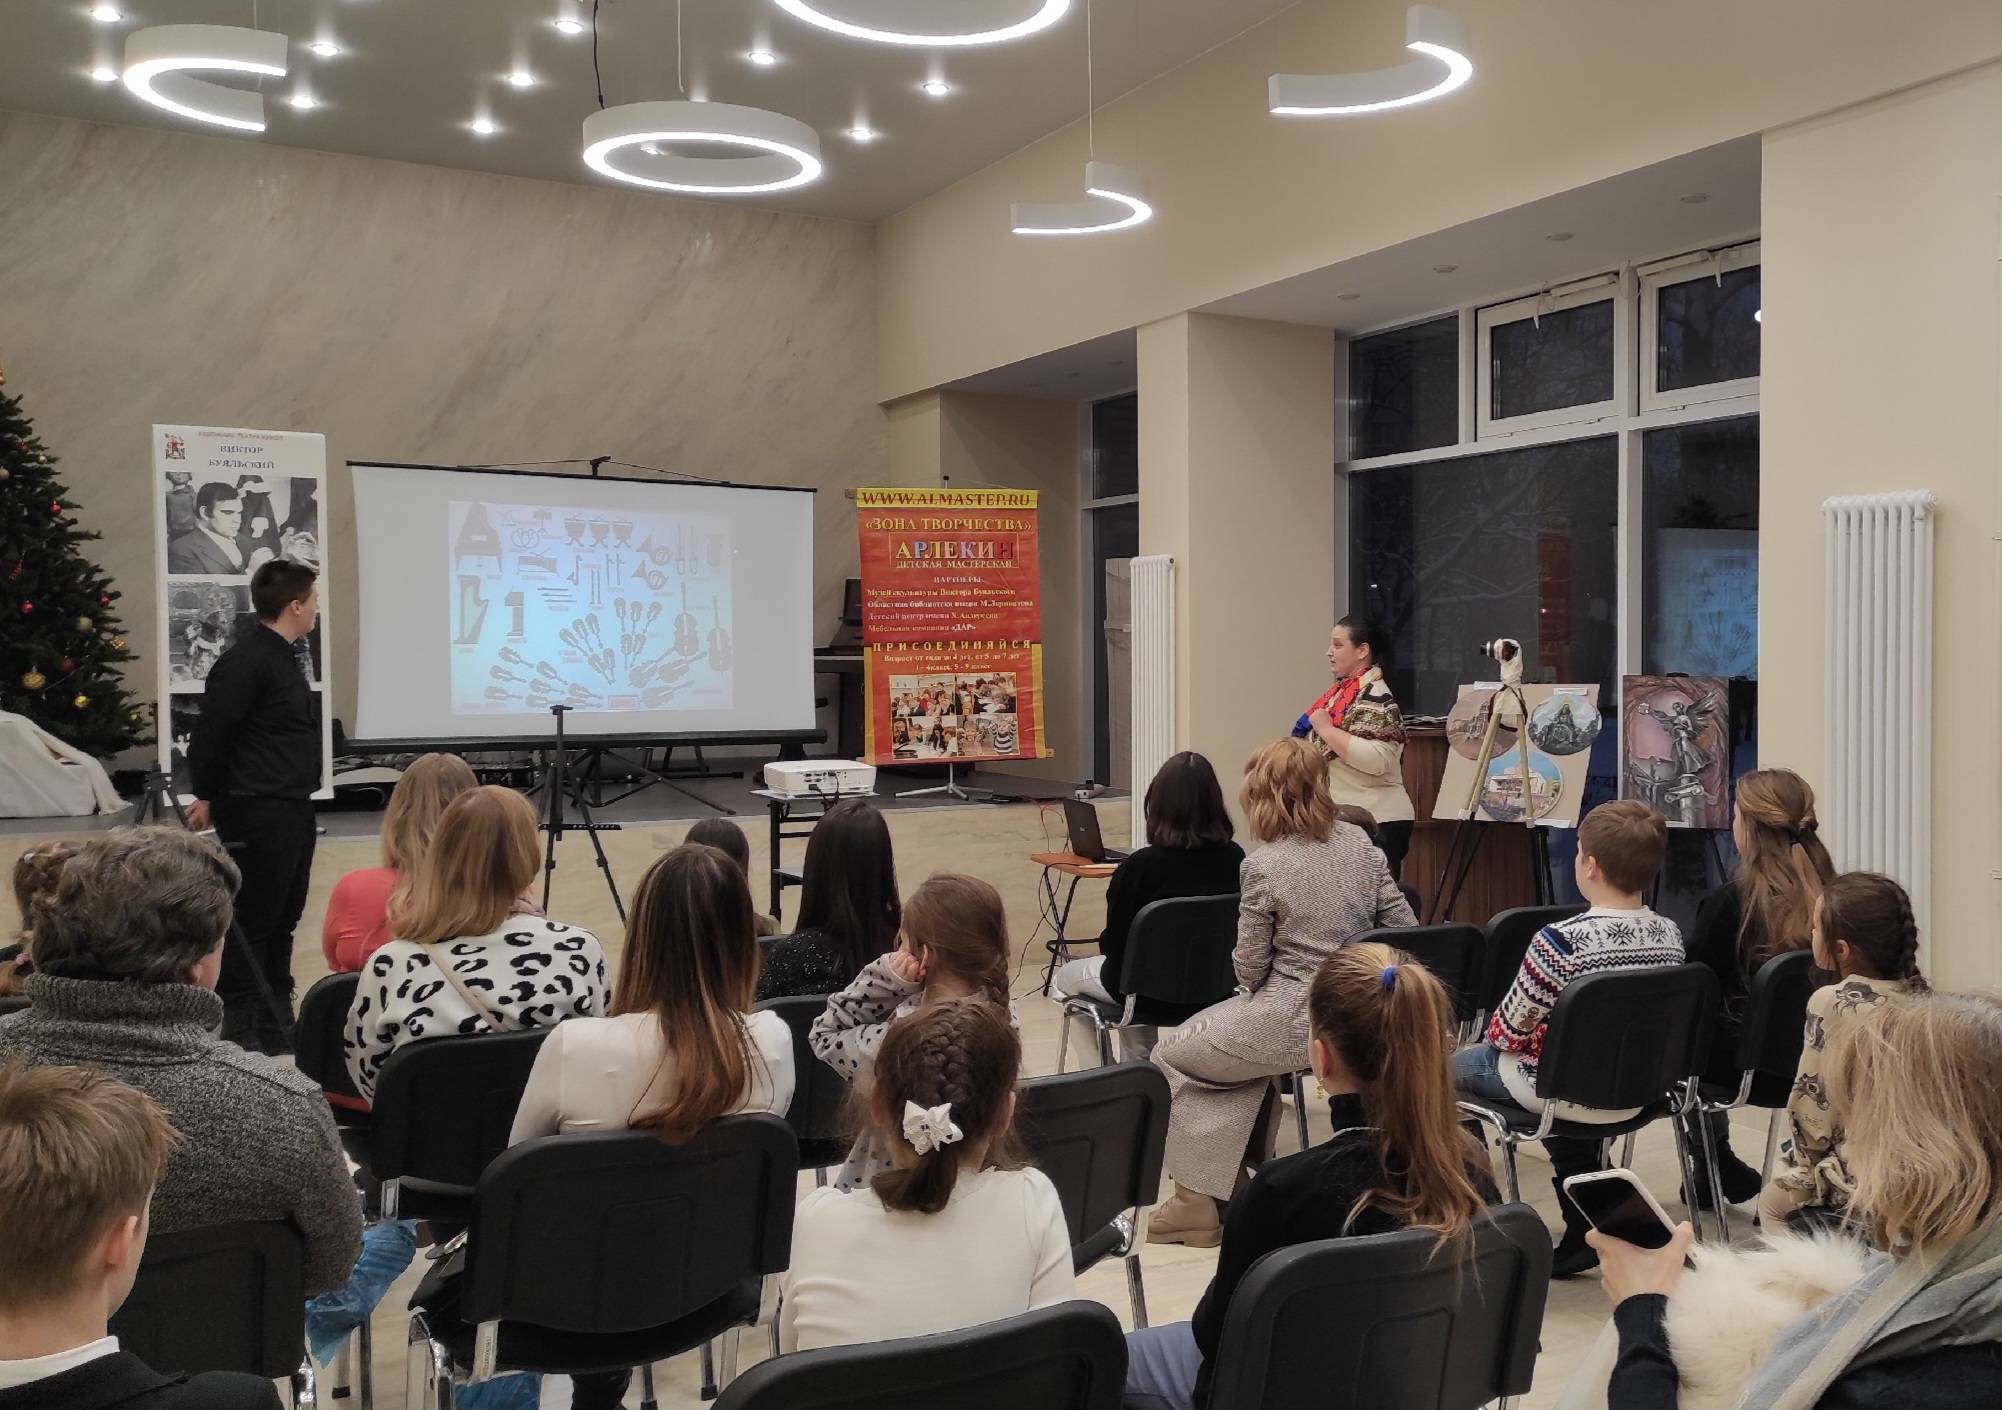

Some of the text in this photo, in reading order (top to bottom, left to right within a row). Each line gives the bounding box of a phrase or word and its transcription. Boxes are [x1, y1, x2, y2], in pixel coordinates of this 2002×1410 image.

[865, 517, 1032, 530] «ЗОНА ТВОРЧЕСТВА»
[895, 540, 1014, 559] АРЛЕКИН
[896, 560, 1012, 568] ДЕТСКАЯ МАСТЕРСКАЯ
